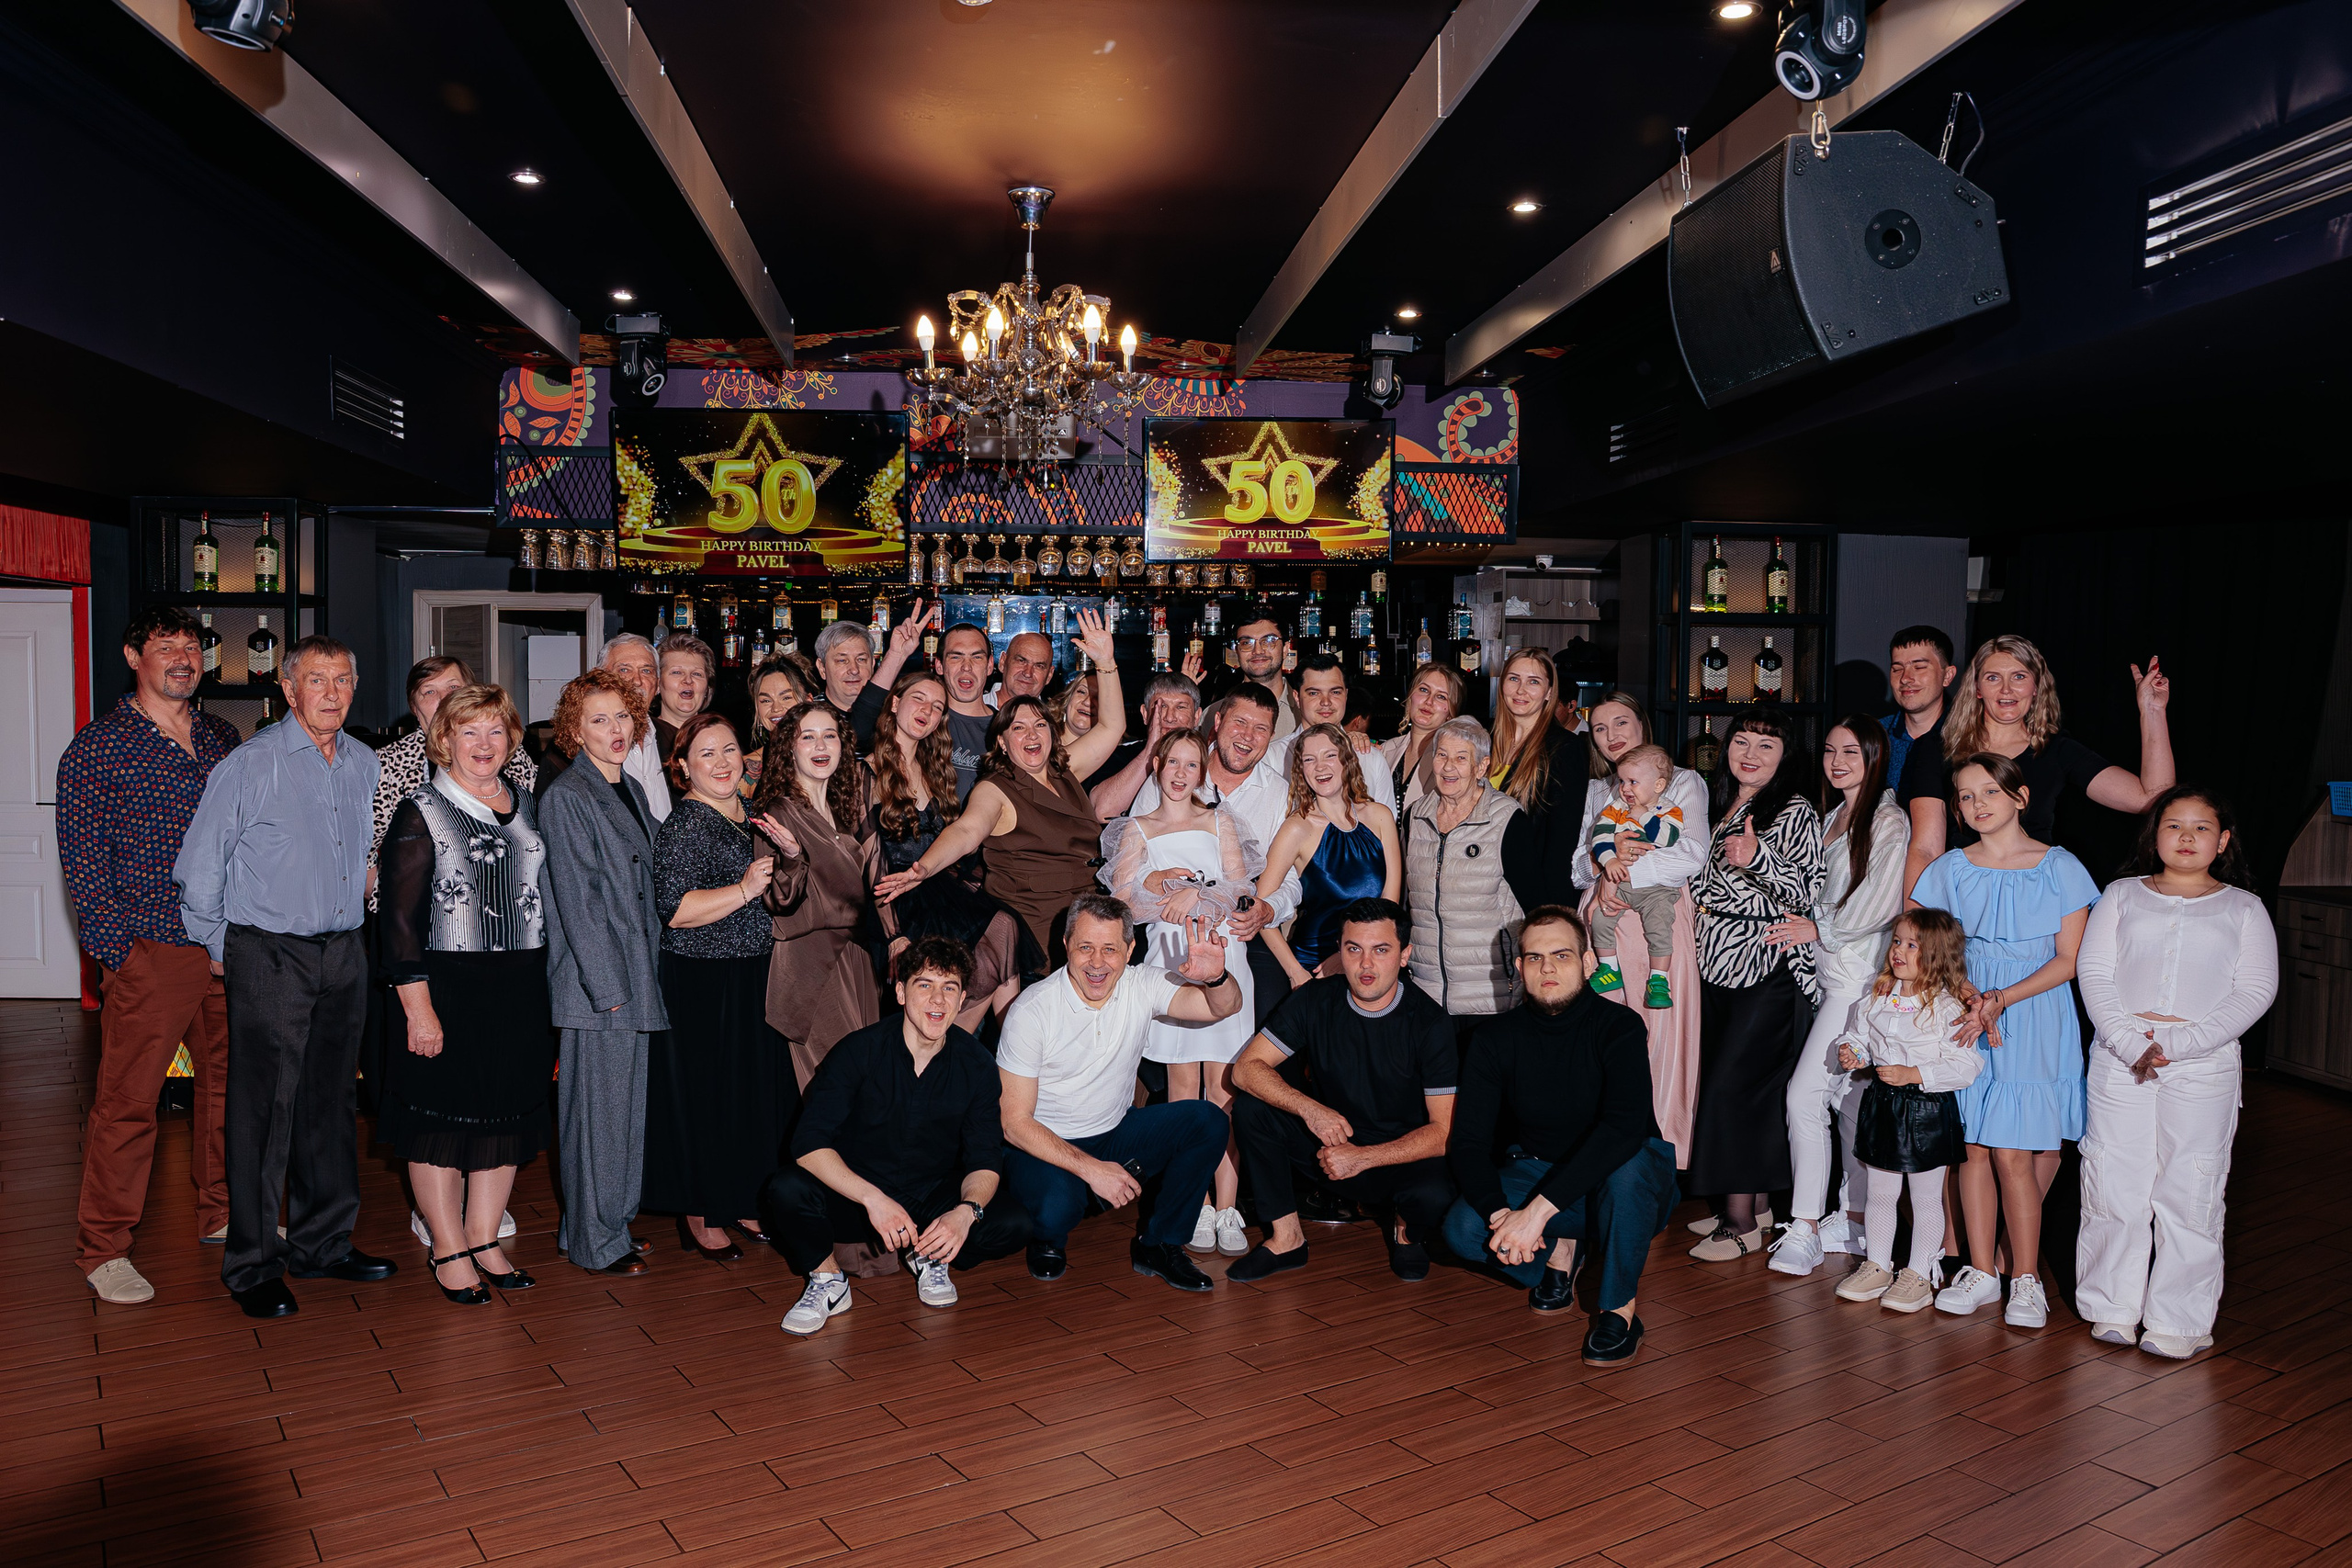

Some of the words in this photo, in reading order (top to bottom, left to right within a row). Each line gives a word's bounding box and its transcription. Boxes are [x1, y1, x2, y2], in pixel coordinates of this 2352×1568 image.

[707, 458, 817, 535] 50
[1224, 459, 1316, 525] 50
[1217, 529, 1257, 539] HAPPY
[1258, 529, 1319, 539] BIRTHDAY
[701, 540, 746, 551] HAPPY
[749, 540, 822, 552] BIRTHDAY
[1248, 541, 1292, 553] PAVEL
[737, 555, 790, 569] PAVEL
